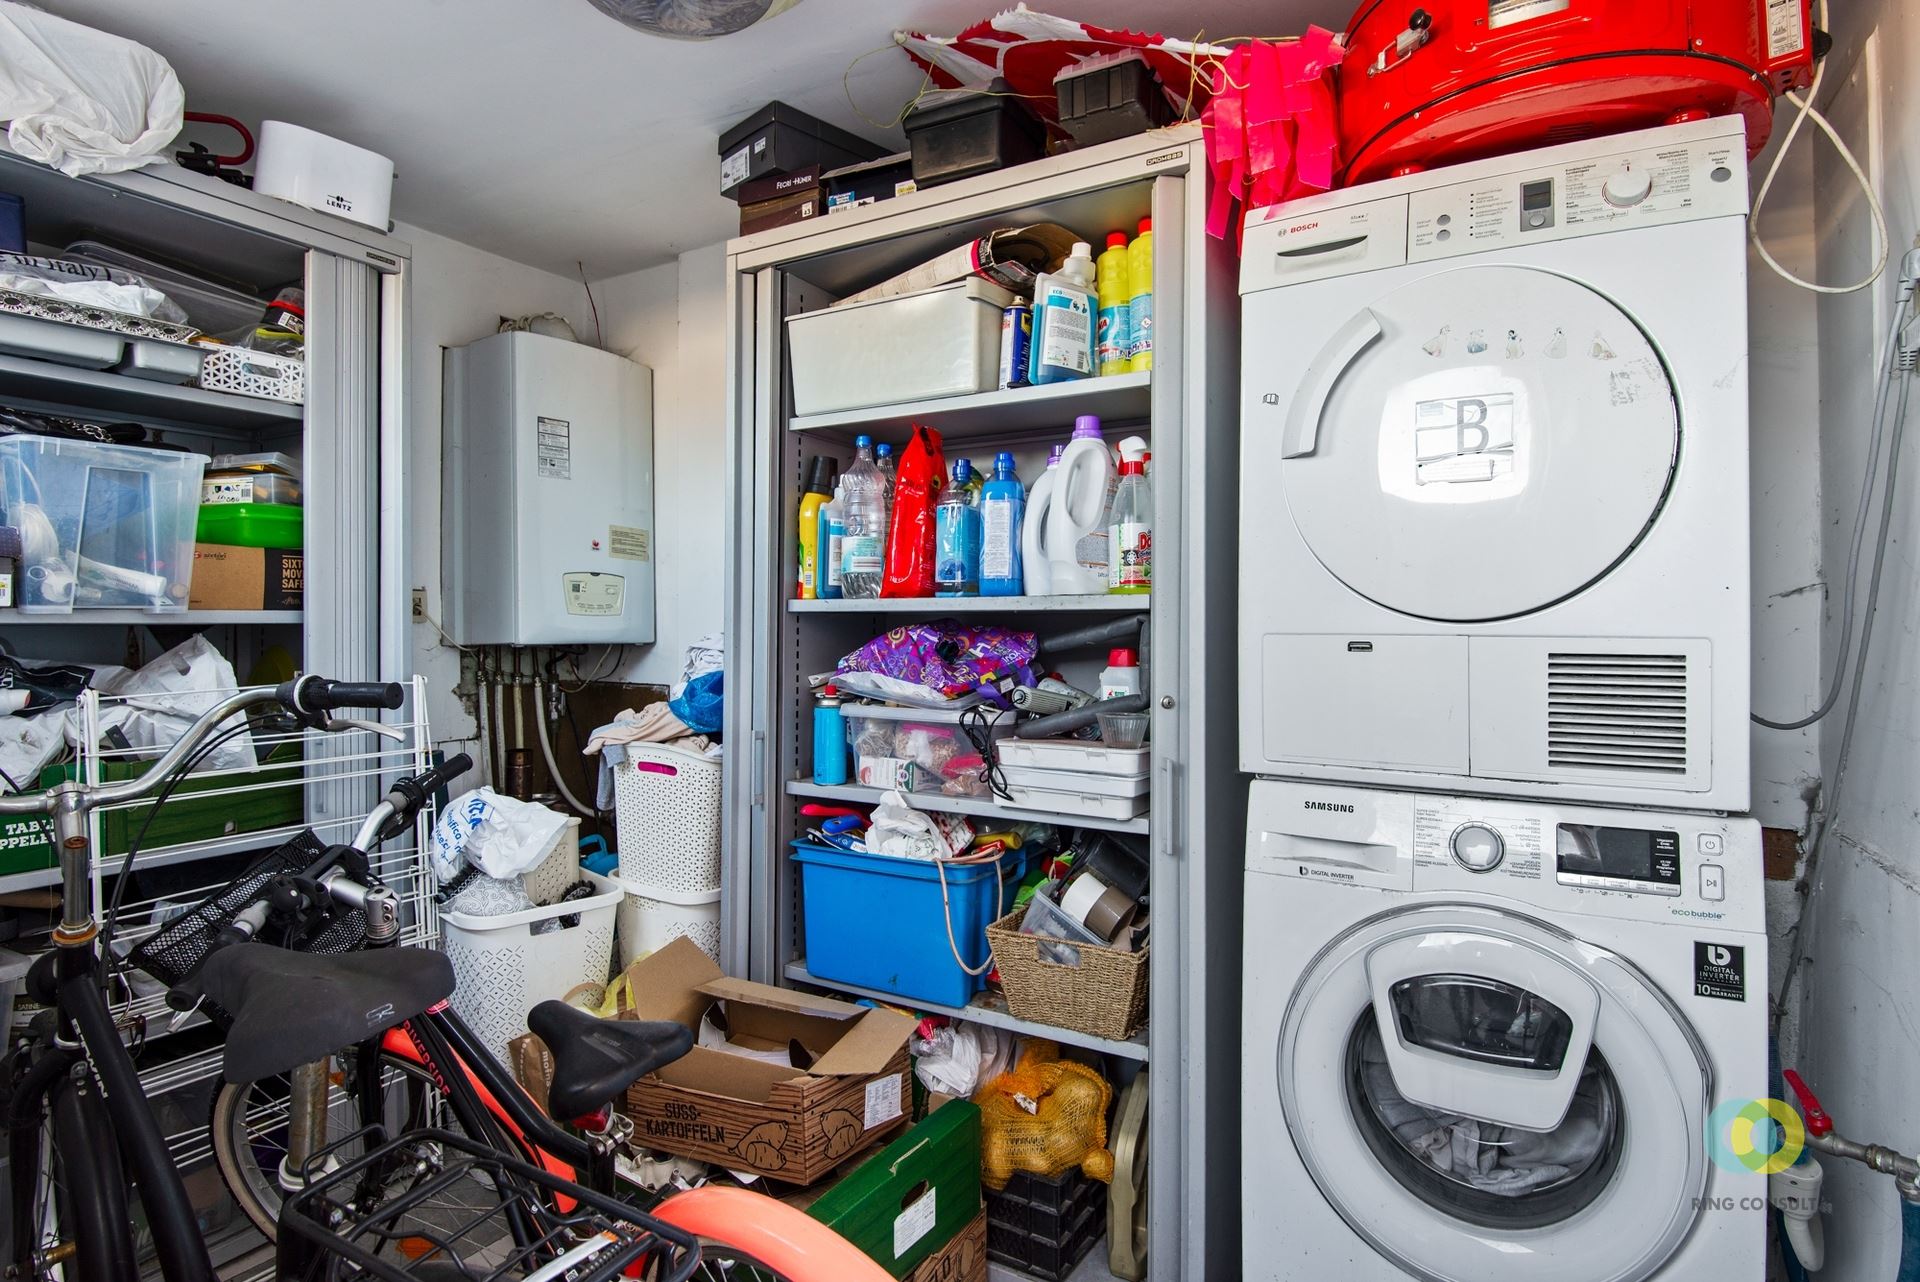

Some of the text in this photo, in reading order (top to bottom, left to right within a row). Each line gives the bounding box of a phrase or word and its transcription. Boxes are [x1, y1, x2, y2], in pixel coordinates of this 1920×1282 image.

[326, 199, 352, 212] LENTZ
[1290, 222, 1319, 234] BOSCH
[282, 558, 303, 569] SIXT
[1304, 801, 1354, 813] SAMSUNG
[1699, 971, 1740, 981] INVERTER
[1703, 965, 1736, 975] DIGITAL
[1696, 983, 1711, 995] 10
[664, 1099, 702, 1121] SÜSS-
[645, 1118, 726, 1143] KARTOFFELN
